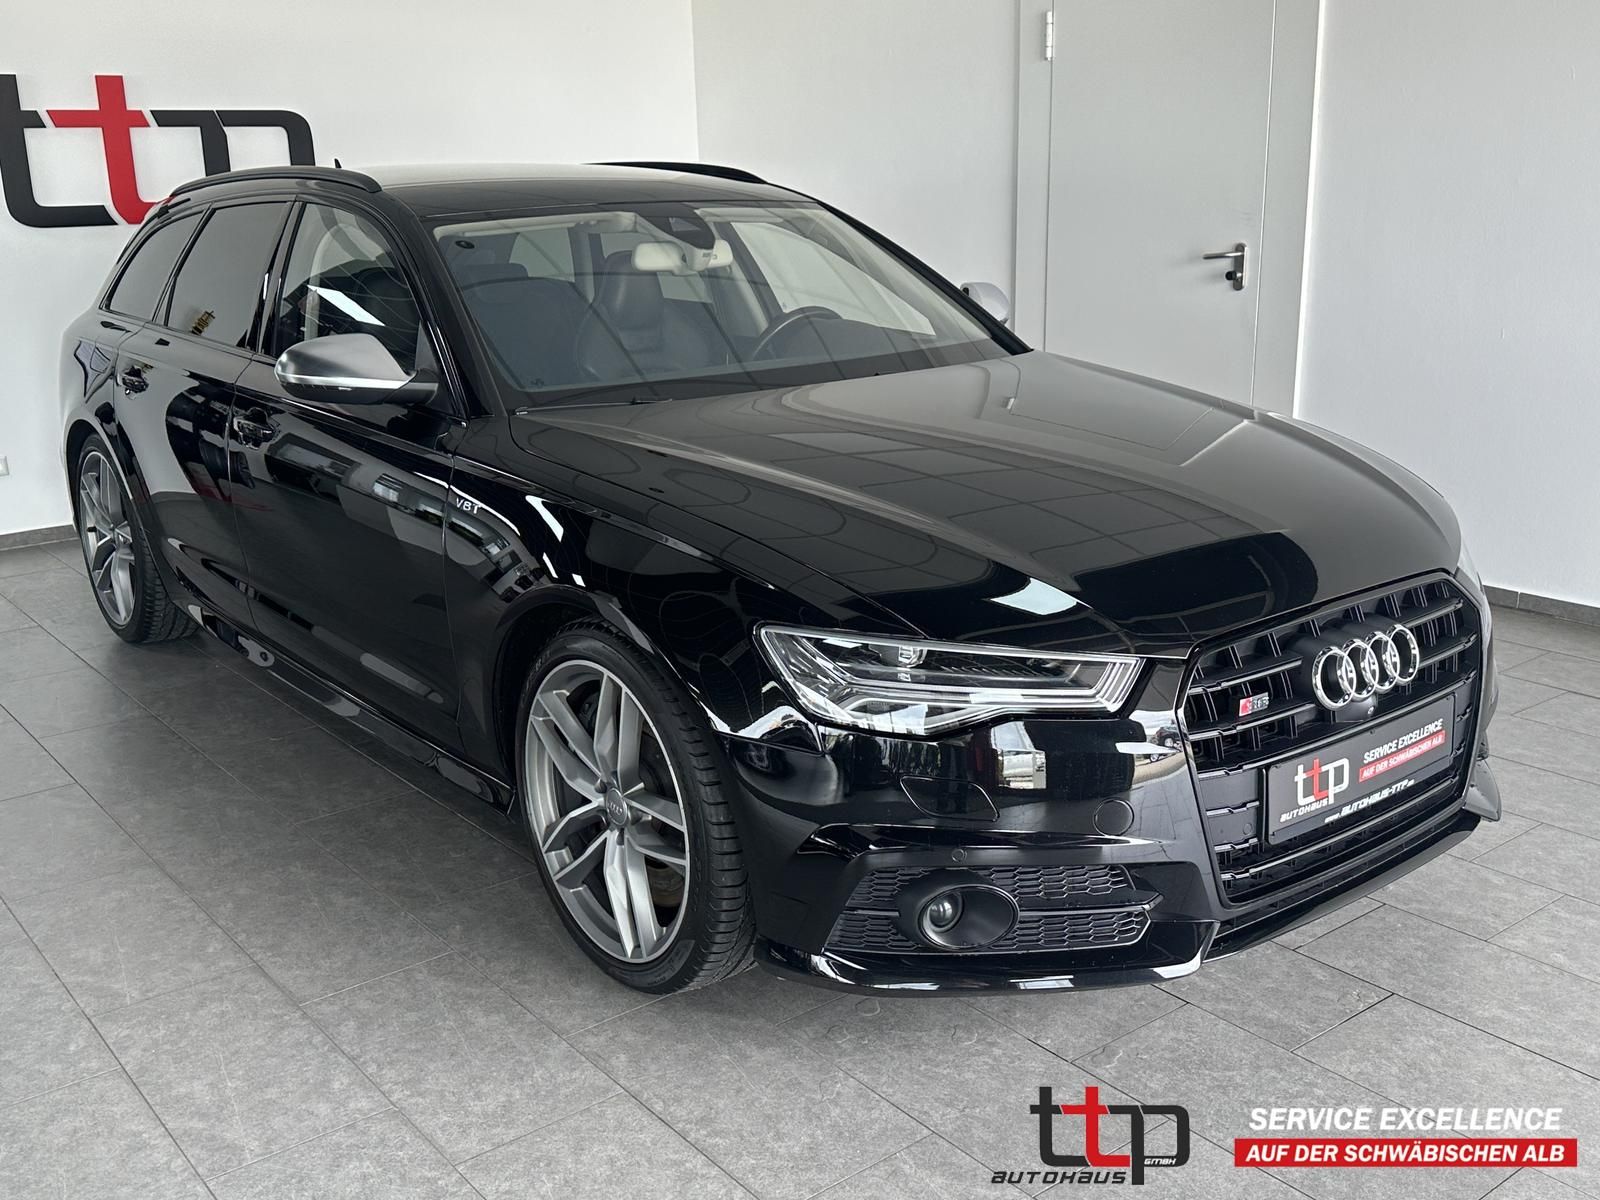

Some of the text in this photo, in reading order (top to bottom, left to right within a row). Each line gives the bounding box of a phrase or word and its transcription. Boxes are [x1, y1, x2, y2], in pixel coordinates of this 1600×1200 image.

[1363, 718, 1443, 764] SERVICE EXCELLENCE
[1362, 765, 1376, 778] AUF
